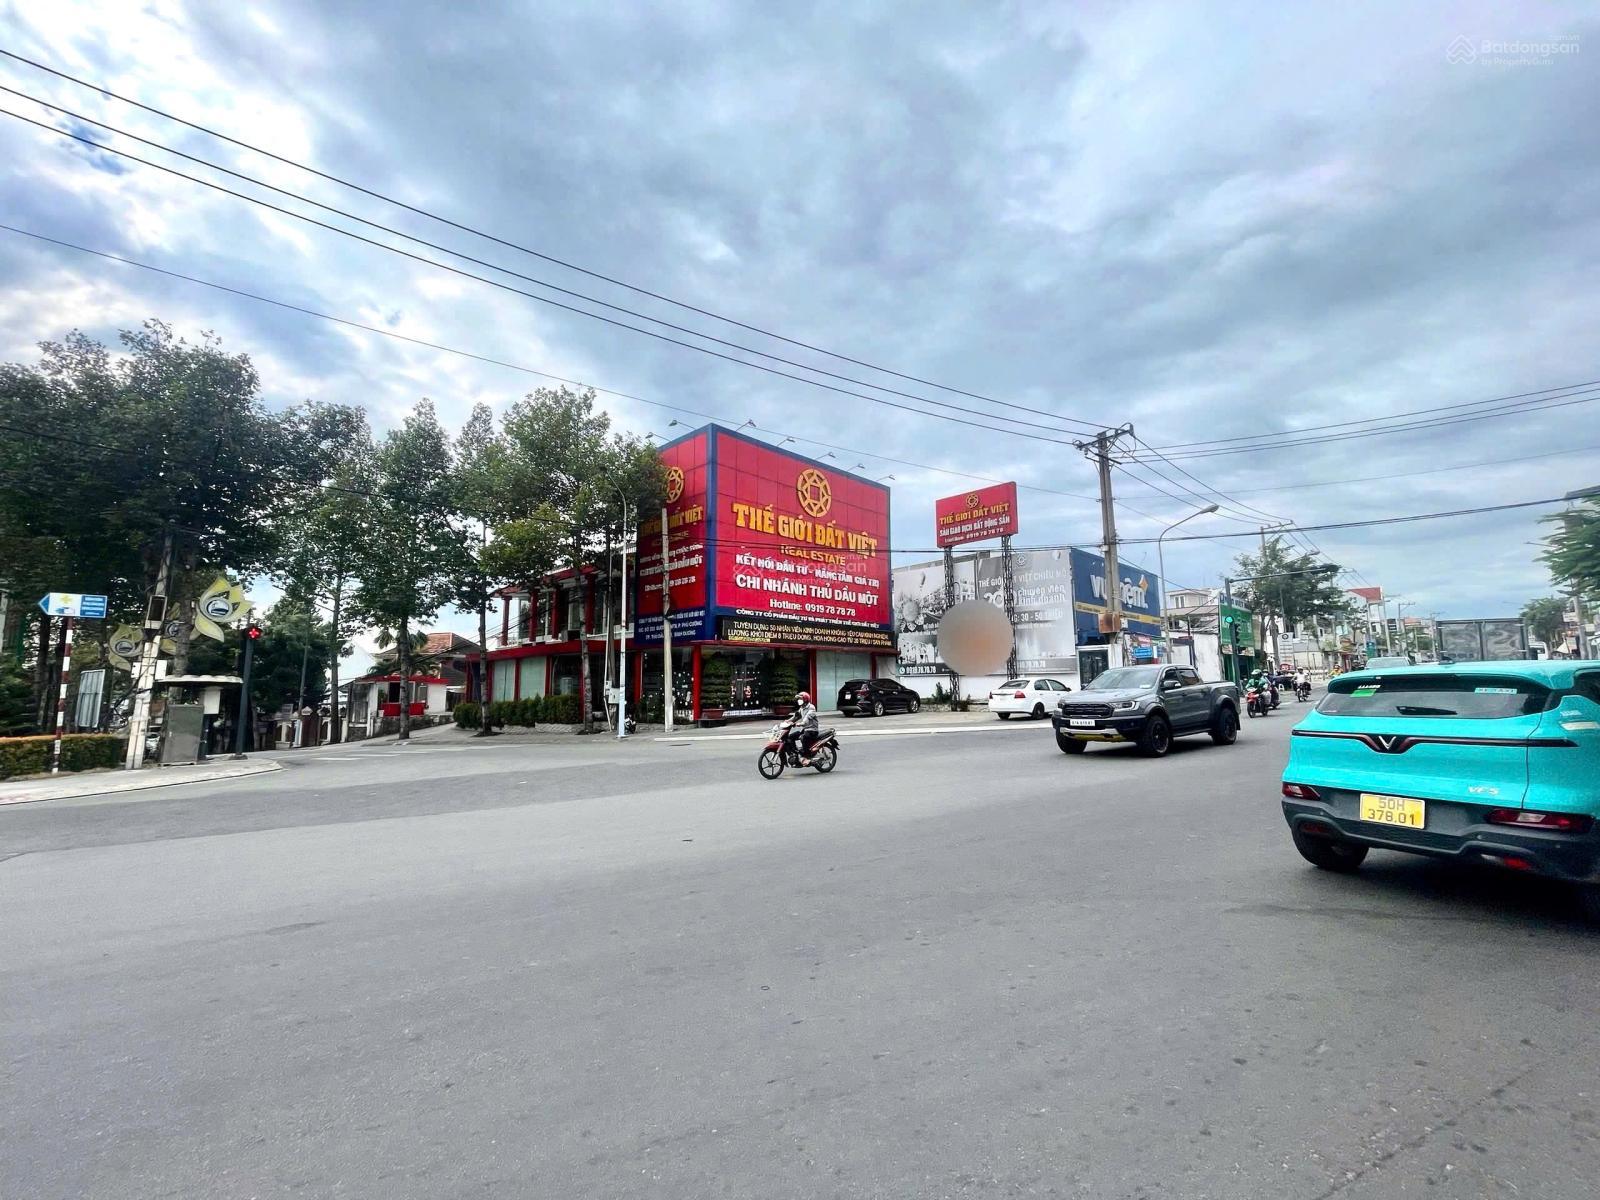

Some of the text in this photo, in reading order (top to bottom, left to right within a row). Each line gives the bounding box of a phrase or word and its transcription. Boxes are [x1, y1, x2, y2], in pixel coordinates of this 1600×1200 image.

[684, 504, 703, 526] VIỆT
[940, 512, 954, 525] THẾ
[973, 505, 990, 518] ĐẤT
[990, 502, 1010, 514] VIỆT
[732, 504, 878, 559] THẾ GIỚI ĐẤT VIỆT
[780, 544, 809, 559] REAL
[811, 551, 846, 566] ESTATE
[735, 552, 757, 567] KẾT
[758, 556, 775, 569] NỐI
[776, 559, 794, 573] ĐẦU
[796, 565, 809, 575] TƯ
[815, 568, 838, 581] NÂNG
[854, 574, 867, 586] GIÁ
[867, 578, 880, 589] TRỊ
[735, 574, 879, 608] CHI NHÁNH THỦ DẦU MỘT
[978, 577, 991, 588] THẾ
[1017, 587, 1046, 597] chuyên
[1018, 591, 1066, 606] kinh doanh
[769, 598, 856, 617] Hotline: 0919 78 78 78
[1020, 612, 1029, 622] 30
[753, 623, 769, 632] DỤNG
[1378, 796, 1406, 811] 50H
[1367, 808, 1416, 826] 378.01
